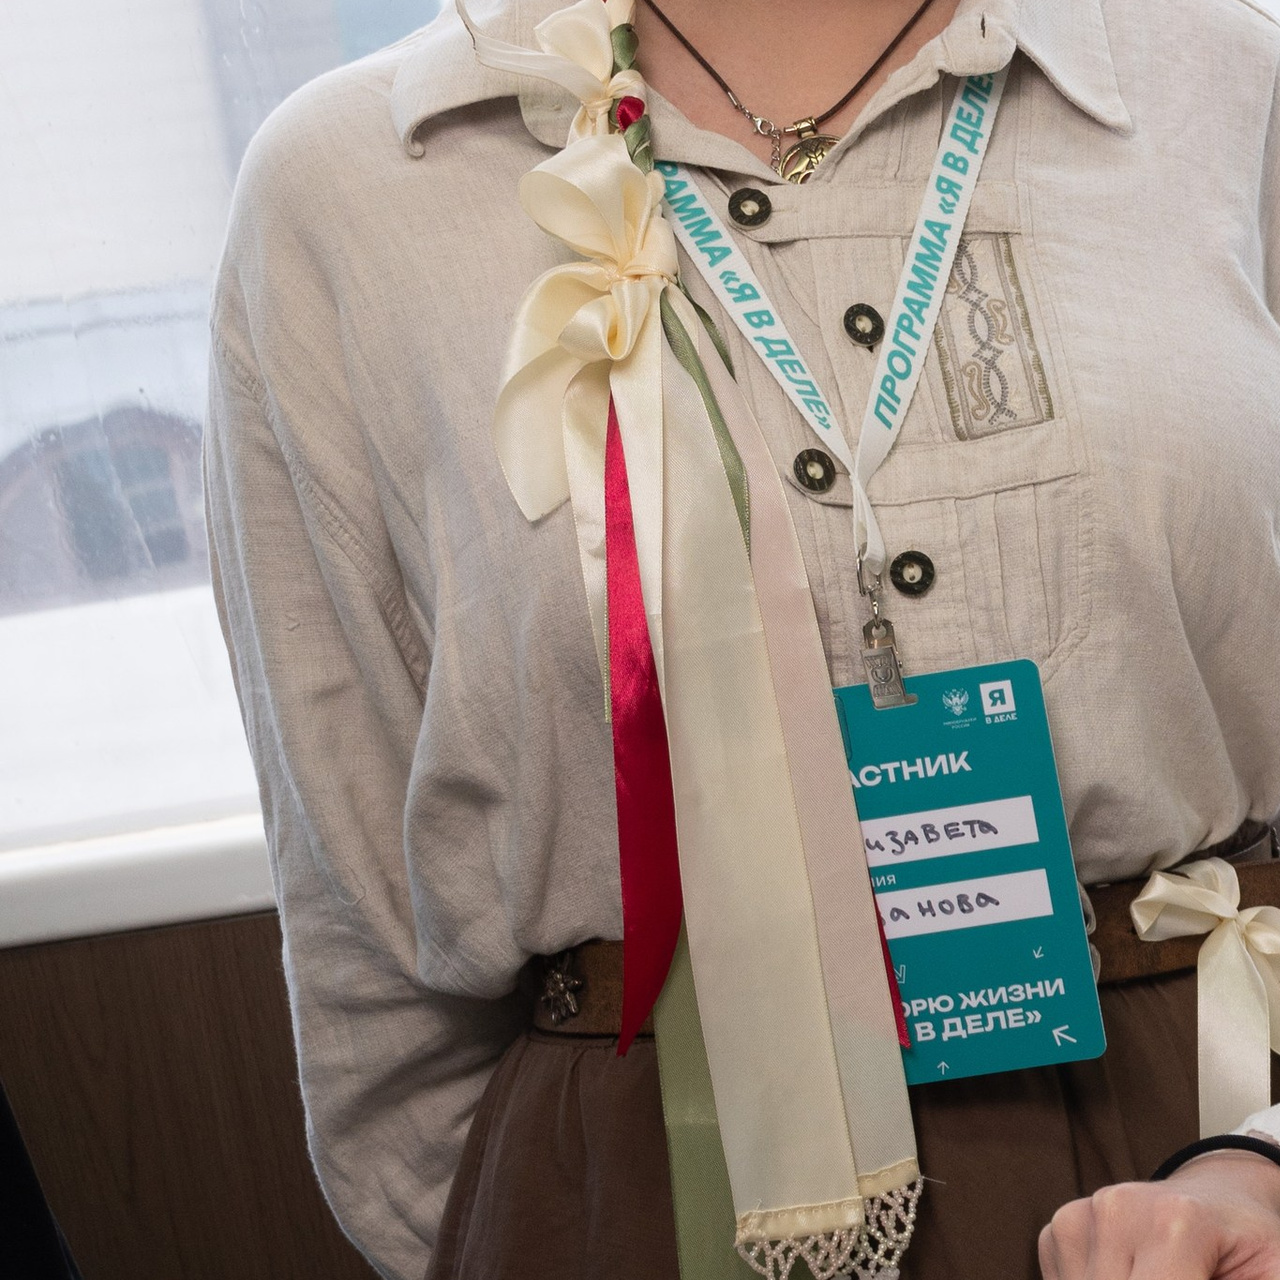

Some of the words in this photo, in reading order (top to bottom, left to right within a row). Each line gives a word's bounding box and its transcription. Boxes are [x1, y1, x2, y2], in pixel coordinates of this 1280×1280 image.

[950, 72, 994, 155] ДЕЛЕ
[941, 151, 970, 176] В
[935, 174, 963, 215] «Я
[654, 160, 733, 269] РАММА
[718, 270, 761, 304] «Я
[743, 308, 776, 330] В
[873, 219, 951, 430] ПРОГРАММА
[753, 335, 832, 431] ДЕЛЕ»
[988, 688, 1007, 707] Я
[985, 716, 992, 724] В
[994, 712, 1017, 723] ДЕЛЕ
[958, 978, 1066, 1010] ЖИЗНИ
[914, 1021, 936, 1042] В
[941, 1008, 1042, 1042] ДЕЛЕ»
